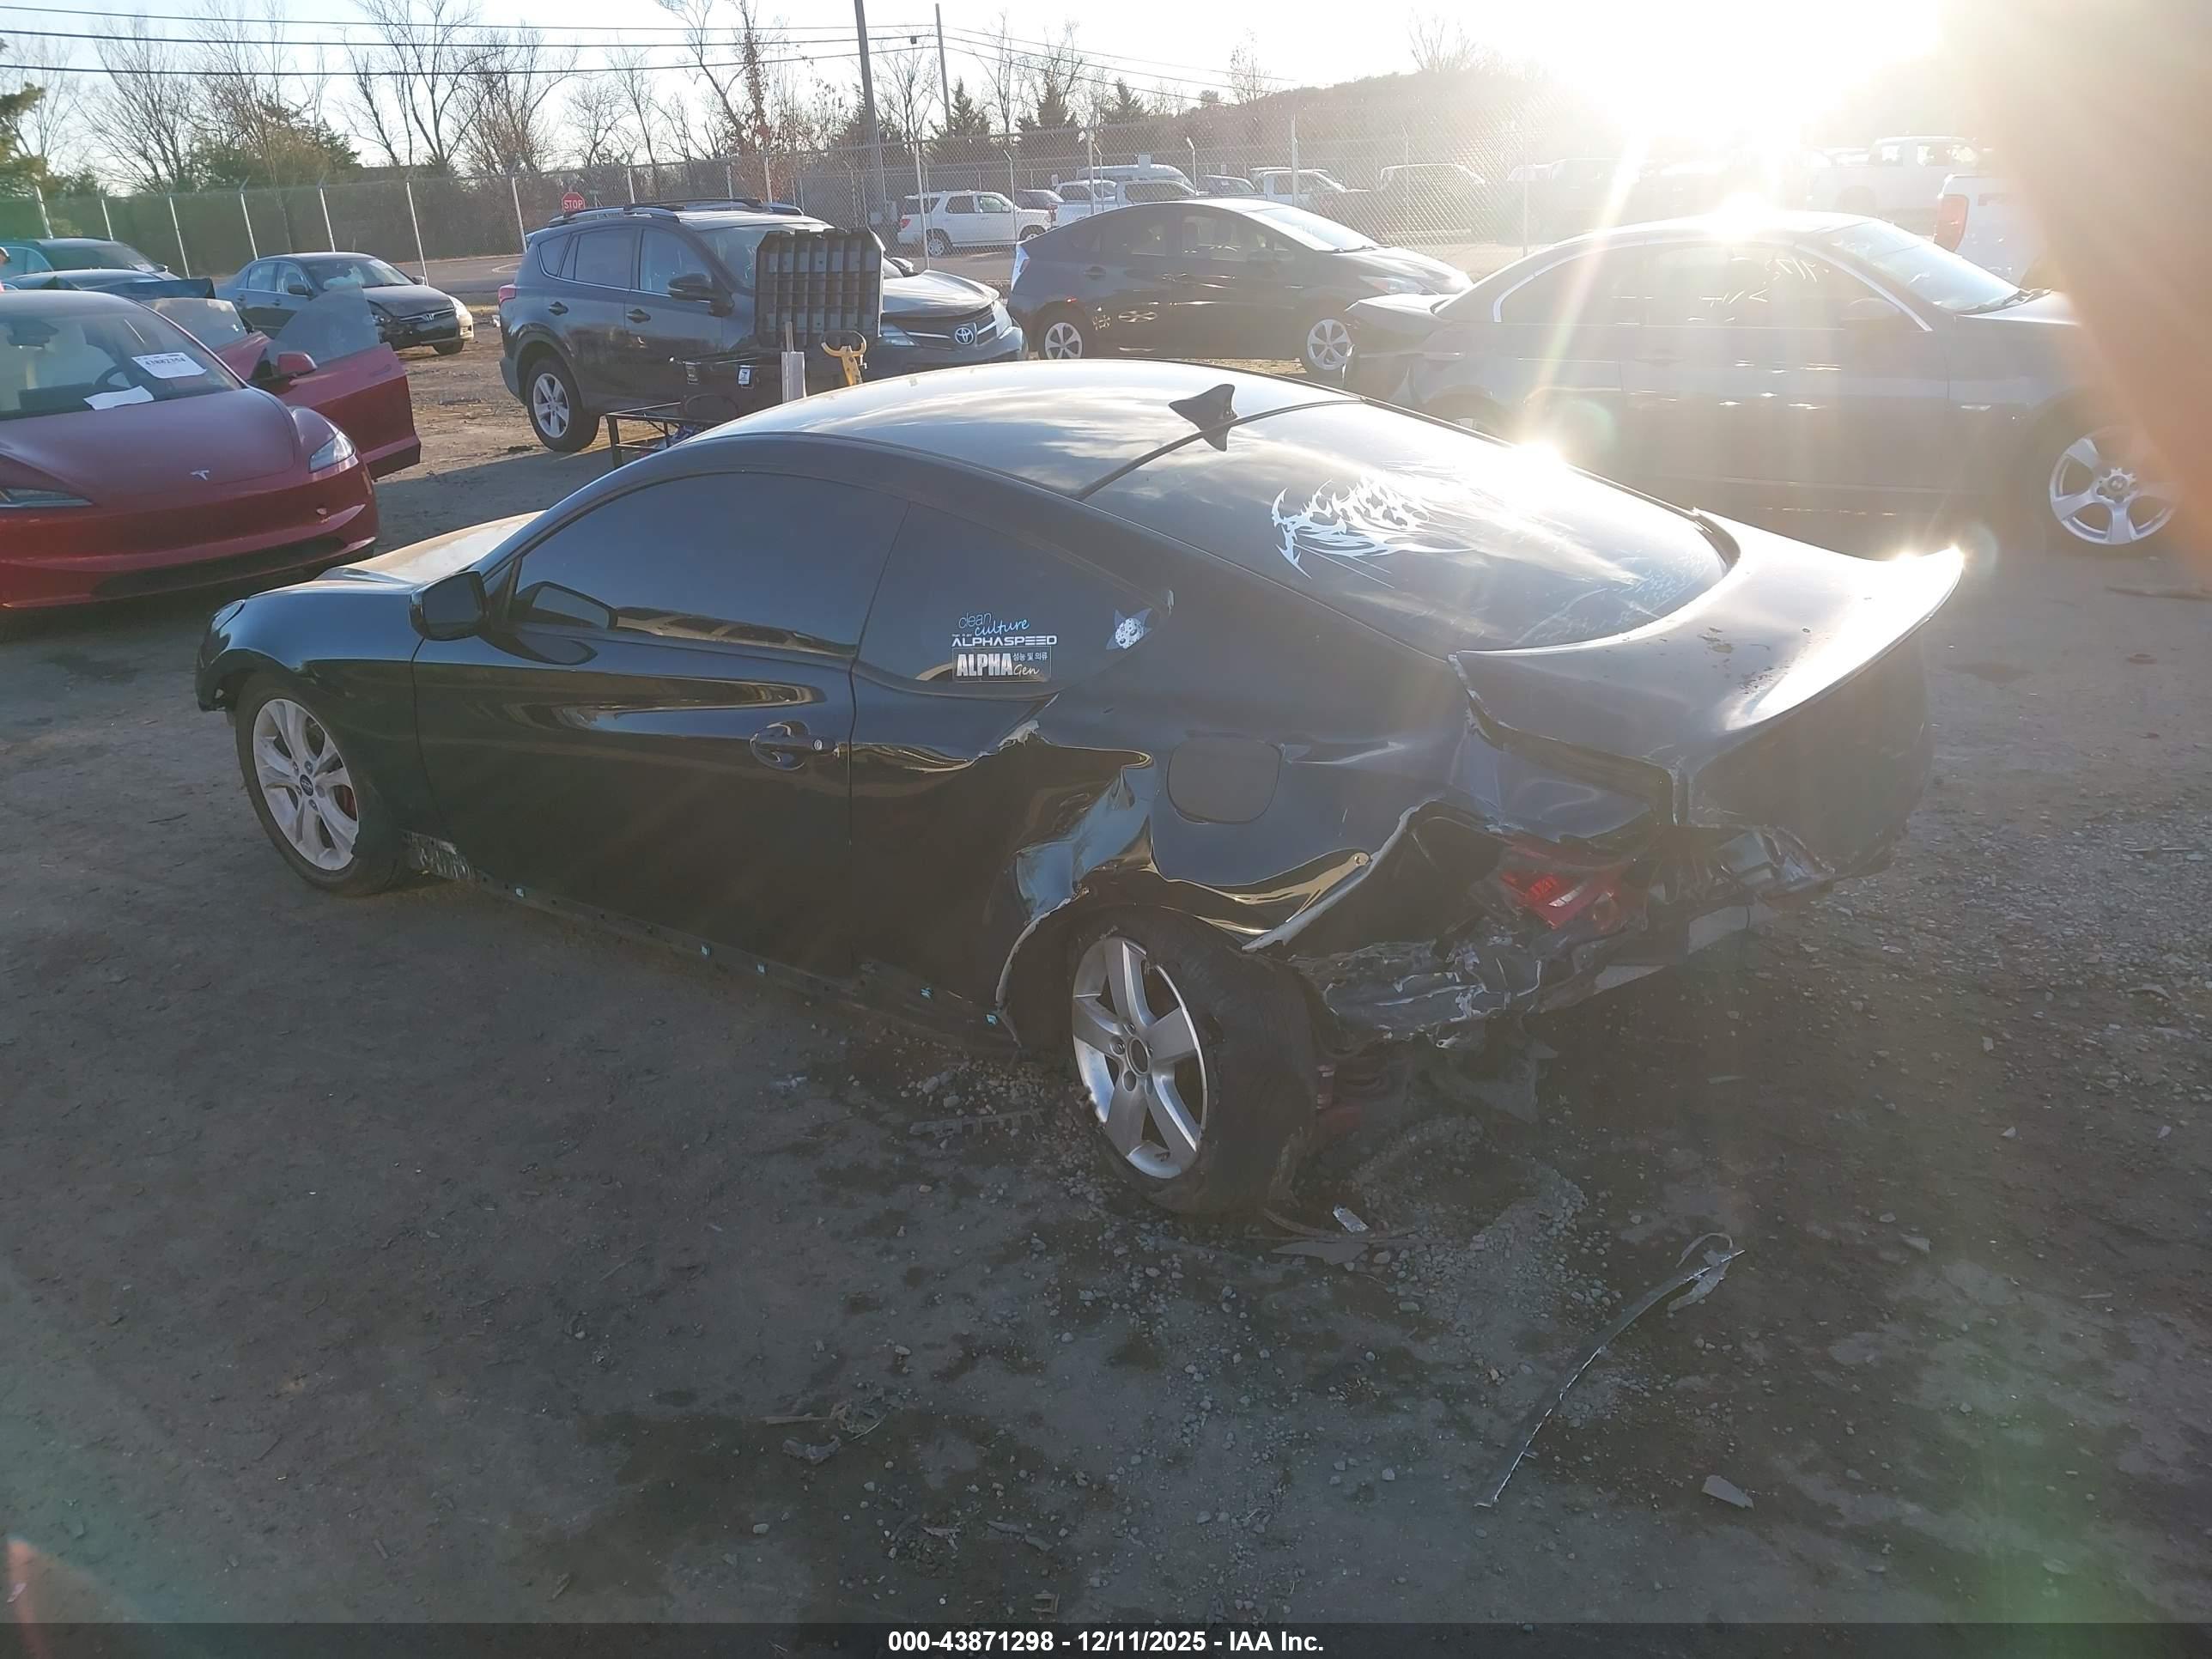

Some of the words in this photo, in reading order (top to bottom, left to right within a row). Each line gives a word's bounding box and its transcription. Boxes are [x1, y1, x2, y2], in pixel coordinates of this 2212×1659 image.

[563, 199, 583, 210] STOP
[958, 612, 992, 629] clean
[975, 619, 1030, 636] culture
[951, 635, 1057, 647] ALPHASPEED
[957, 653, 1013, 677] ALPHA
[1013, 664, 1040, 677] Gen
